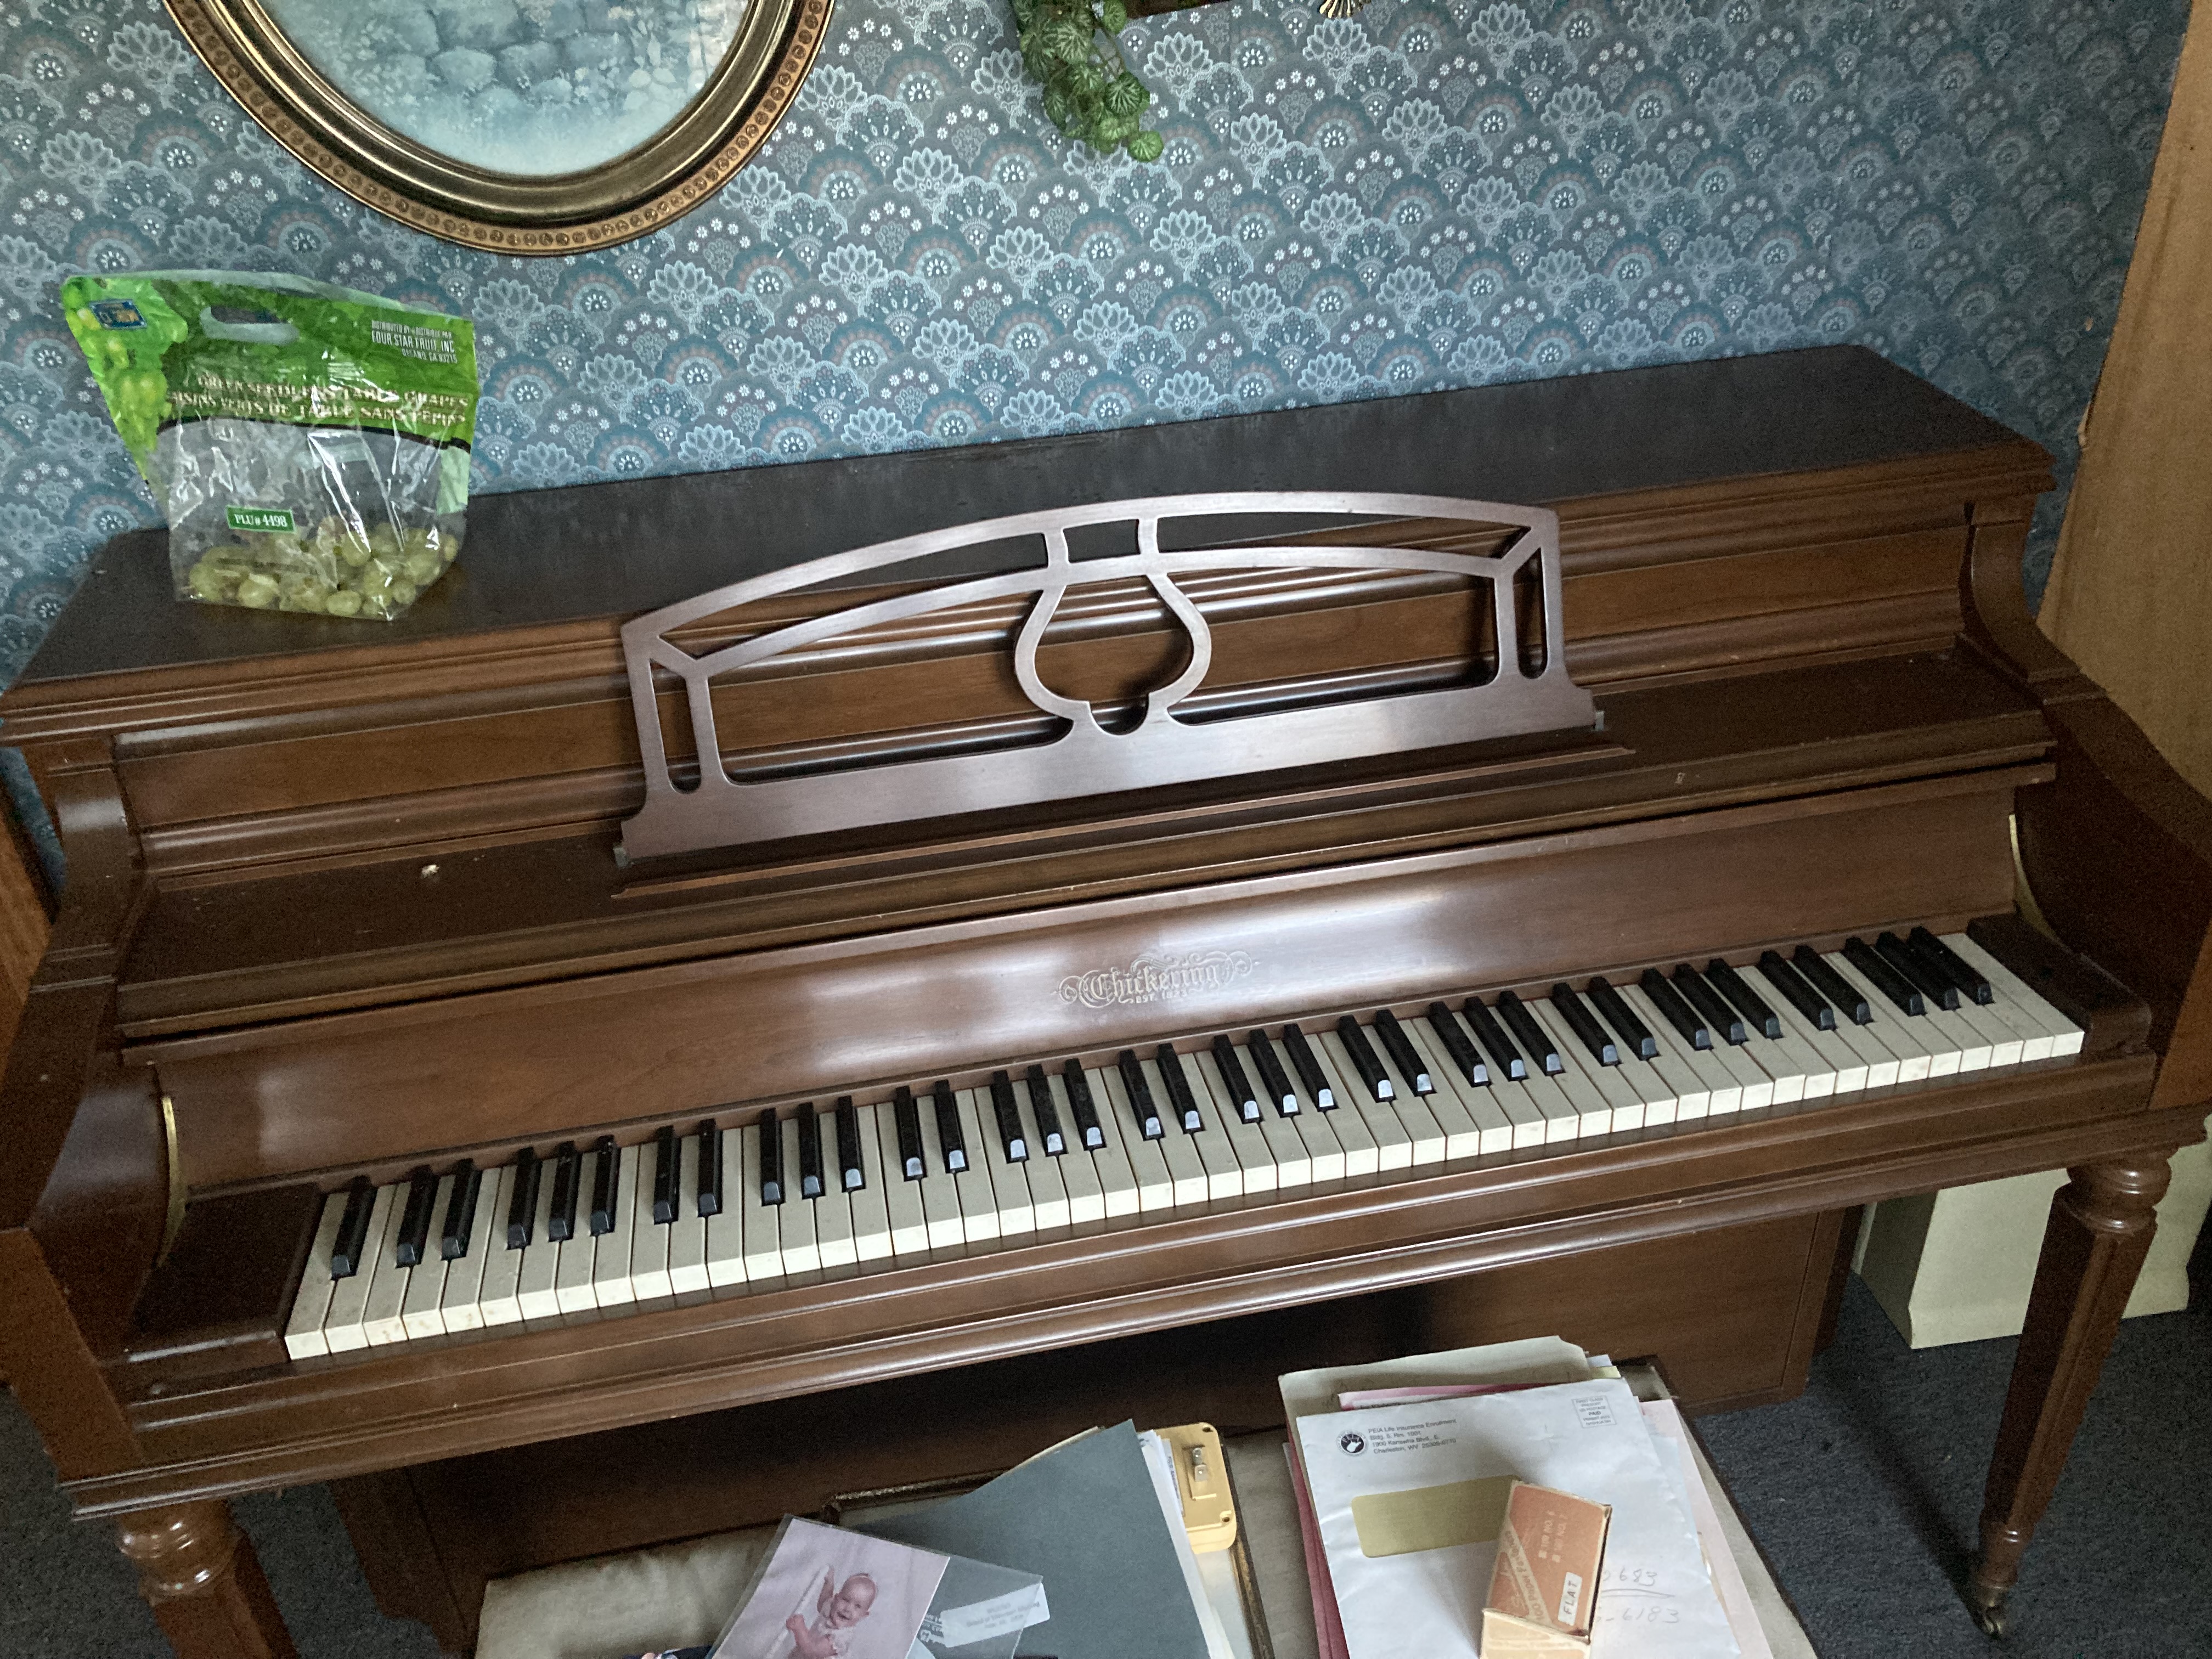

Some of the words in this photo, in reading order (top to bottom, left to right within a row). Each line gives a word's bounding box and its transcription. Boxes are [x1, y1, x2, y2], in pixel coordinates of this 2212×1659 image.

[371, 330, 392, 346] FOUR
[393, 333, 413, 348] STAR
[172, 391, 217, 409] AISINS
[360, 407, 406, 421] SANS
[404, 390, 468, 407] GRAPES
[263, 513, 287, 527] 4498
[1081, 964, 1220, 1004] Chickering
[1425, 1419, 1457, 1427] Enrollment
[1564, 1580, 1578, 1615] FLAT
